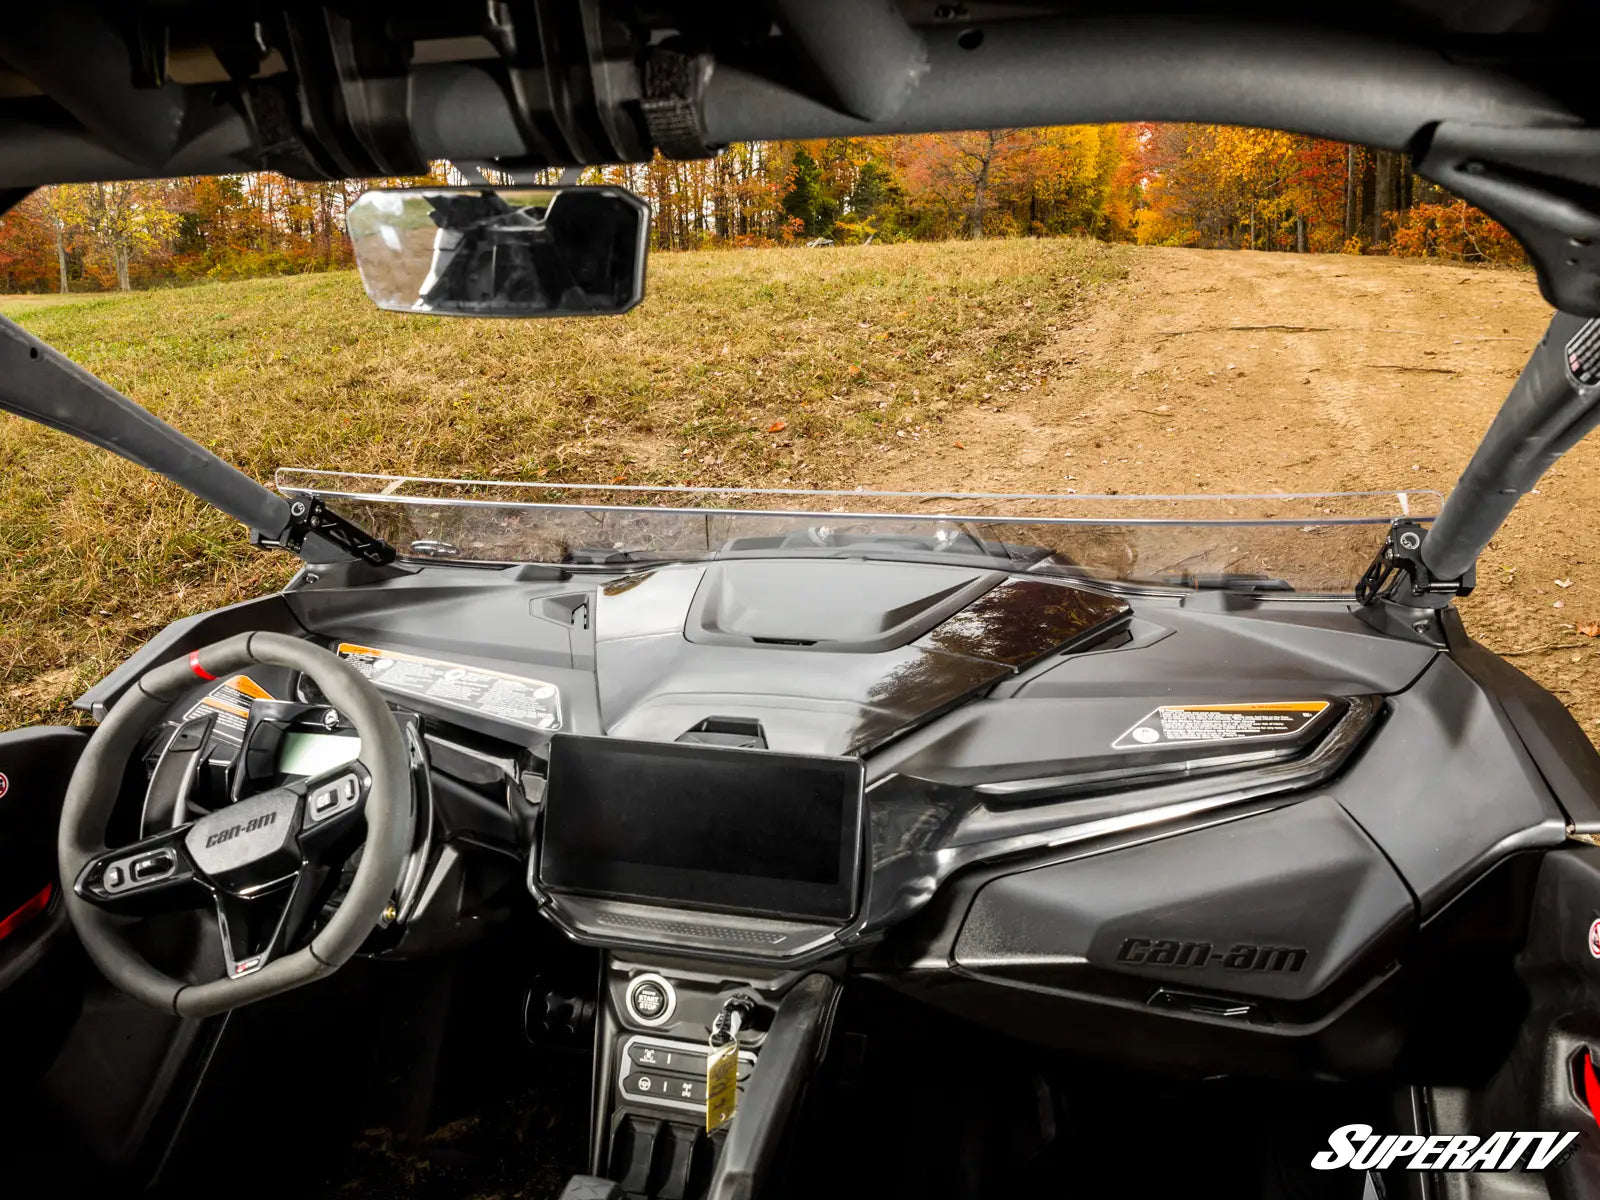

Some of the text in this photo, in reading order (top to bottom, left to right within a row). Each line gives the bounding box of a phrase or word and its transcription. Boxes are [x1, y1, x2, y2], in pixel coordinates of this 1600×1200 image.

[206, 811, 277, 848] can-am
[1117, 938, 1309, 972] can-am
[639, 994, 659, 1003] START
[639, 1002, 657, 1010] STOP
